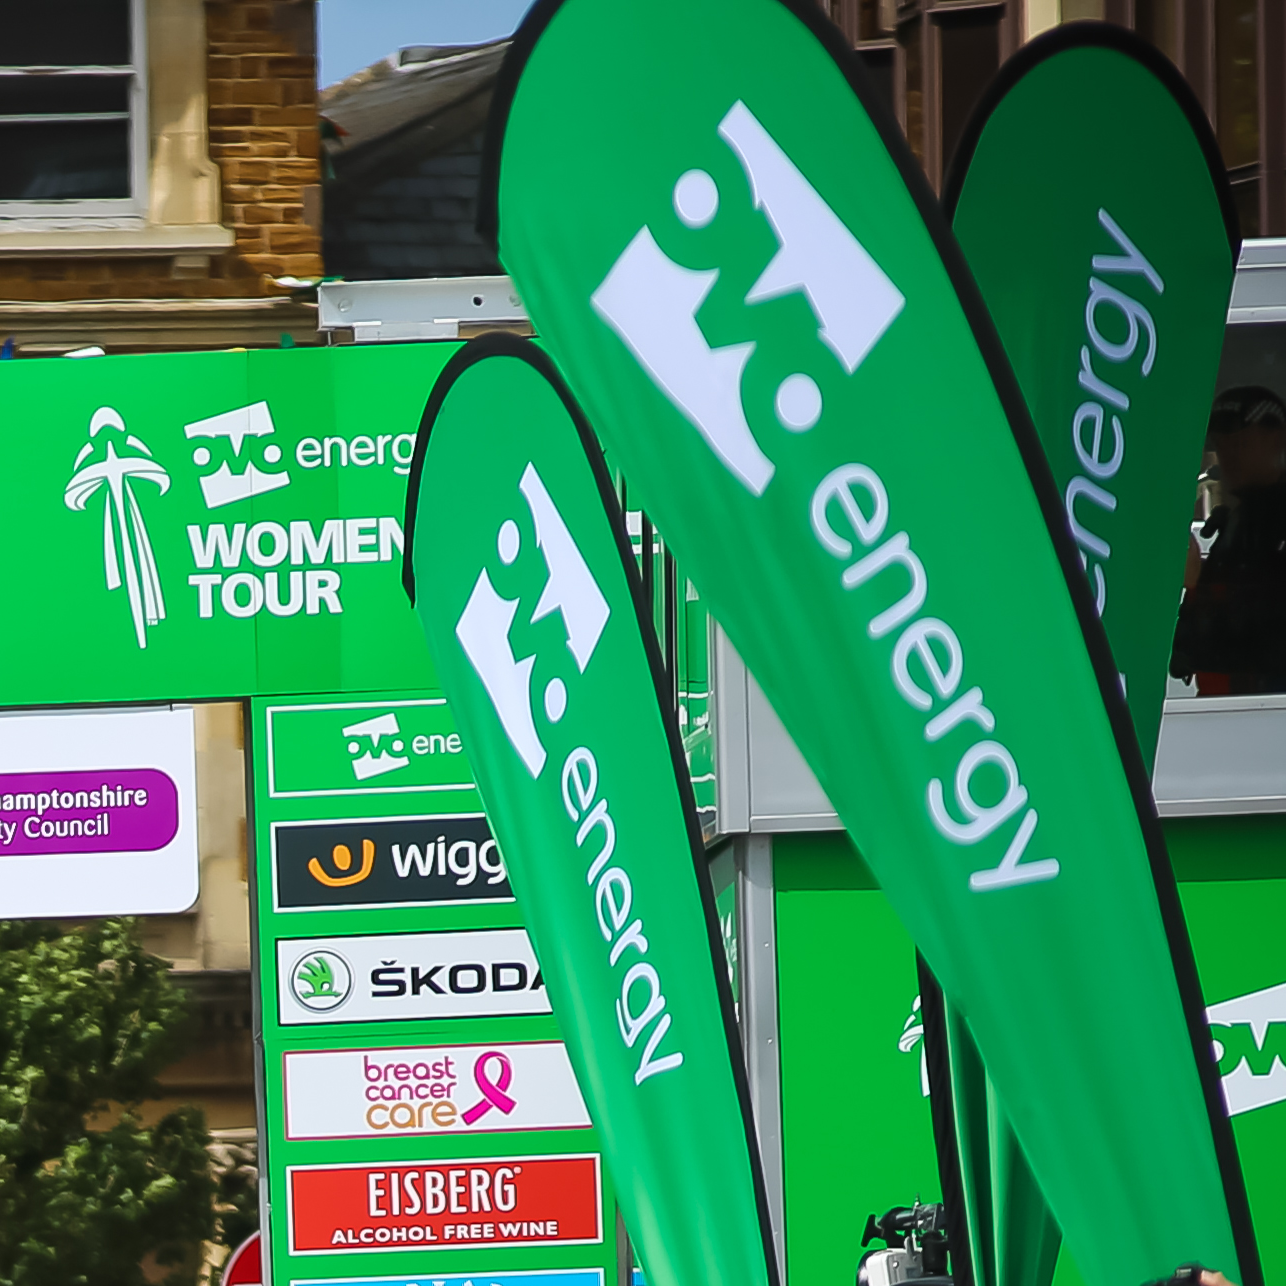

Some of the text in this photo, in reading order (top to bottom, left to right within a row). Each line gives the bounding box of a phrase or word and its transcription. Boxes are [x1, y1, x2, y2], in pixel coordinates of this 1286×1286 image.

[1063, 206, 1165, 618] nergy
[188, 570, 344, 619] TOUR
[809, 462, 1062, 891] energy
[24, 814, 109, 839] Council
[562, 746, 685, 1087] energy
[364, 1055, 457, 1083] breast
[365, 1082, 457, 1102] cancer
[366, 1100, 457, 1130] care
[368, 1167, 517, 1218] EISBERG
[331, 1221, 558, 1245] ALCOHOL FREE WINE
